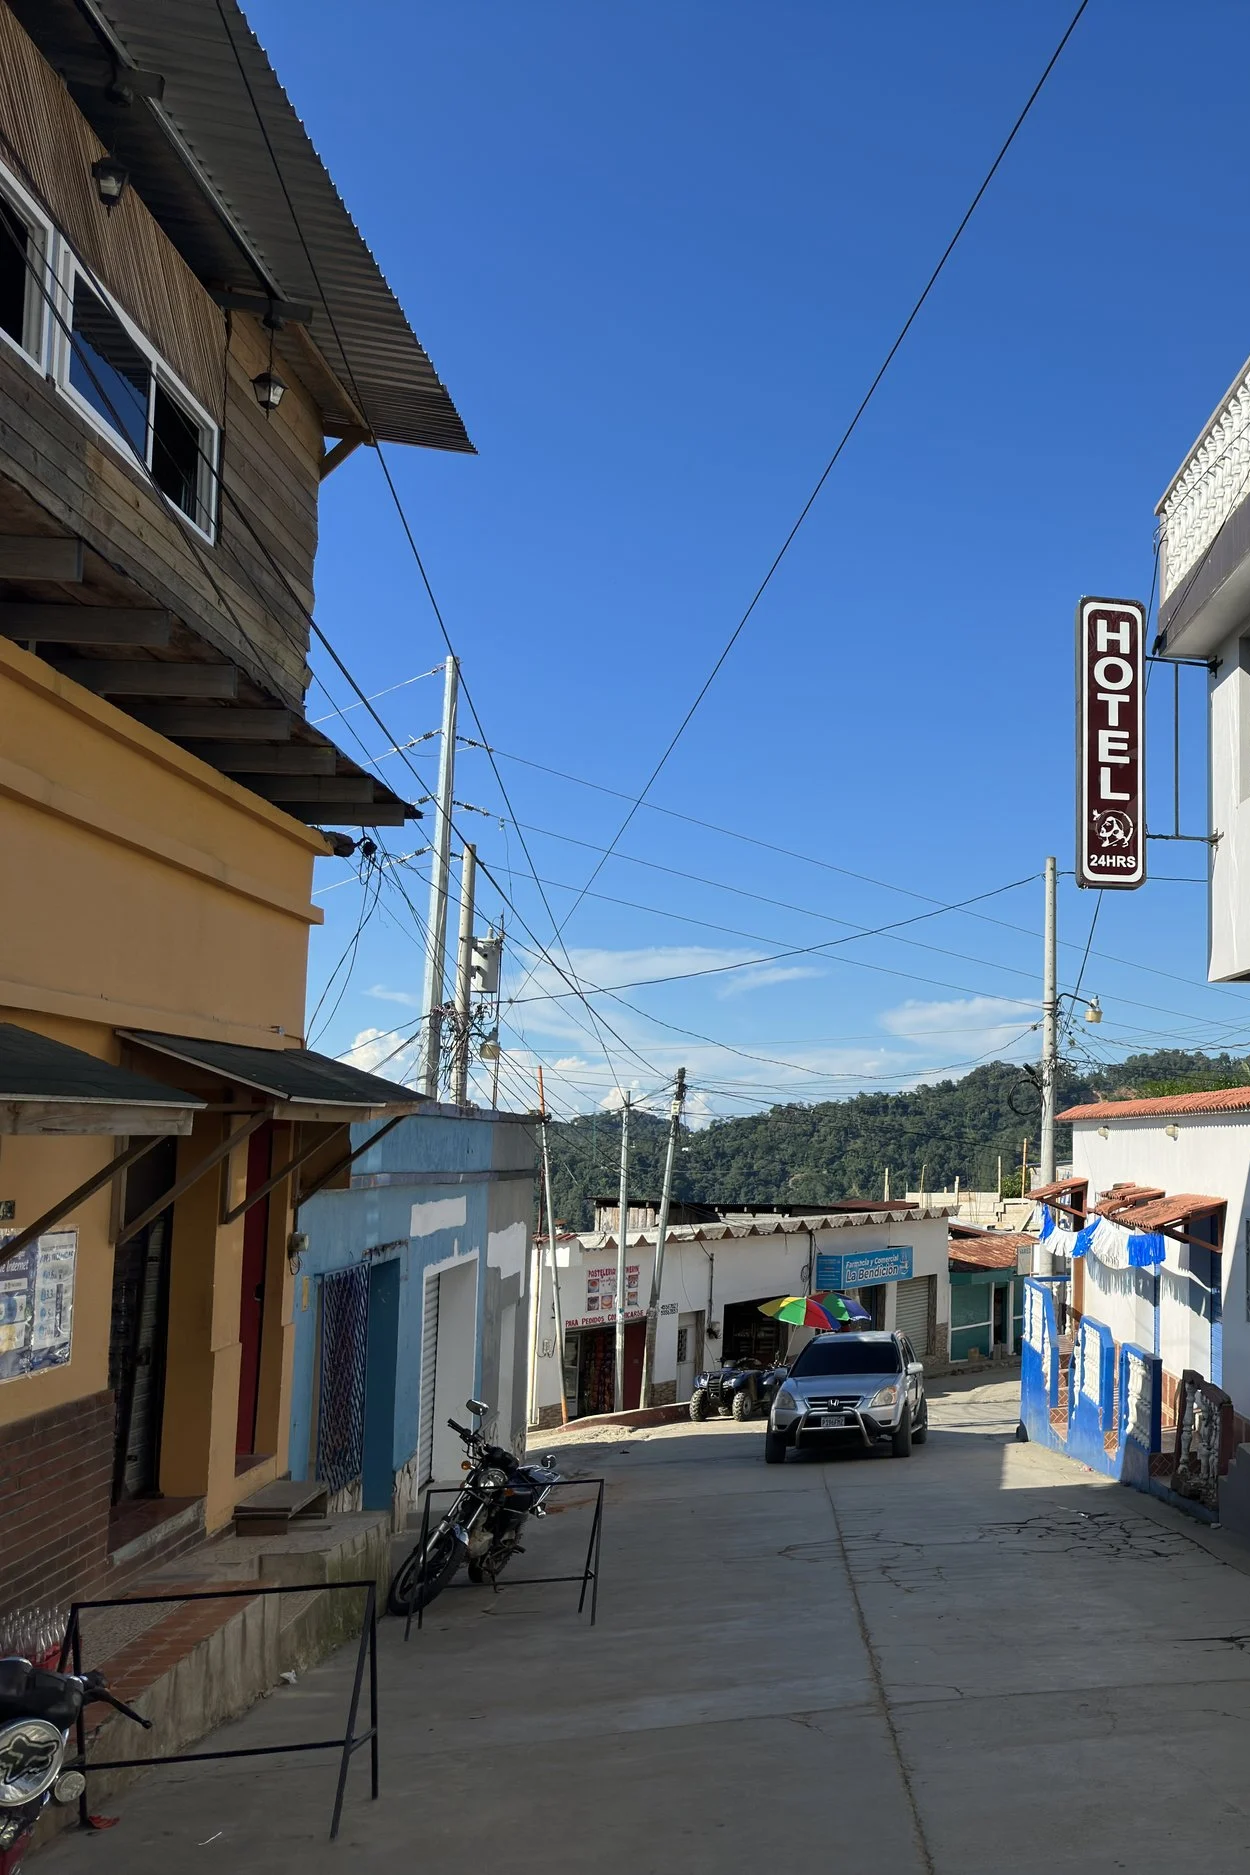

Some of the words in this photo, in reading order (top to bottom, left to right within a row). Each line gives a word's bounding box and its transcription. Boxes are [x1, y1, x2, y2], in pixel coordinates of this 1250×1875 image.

[1093, 619, 1133, 801] HOTEL
[1090, 854, 1136, 868] 24HRS
[6, 1258, 29, 1273] Internet
[846, 1258, 870, 1269] Farmacia
[875, 1254, 899, 1264] Comercial
[846, 1269, 857, 1283] La
[858, 1263, 899, 1281] Bendición
[565, 1319, 578, 1328] PARA
[581, 1316, 605, 1325] PEDIDOS
